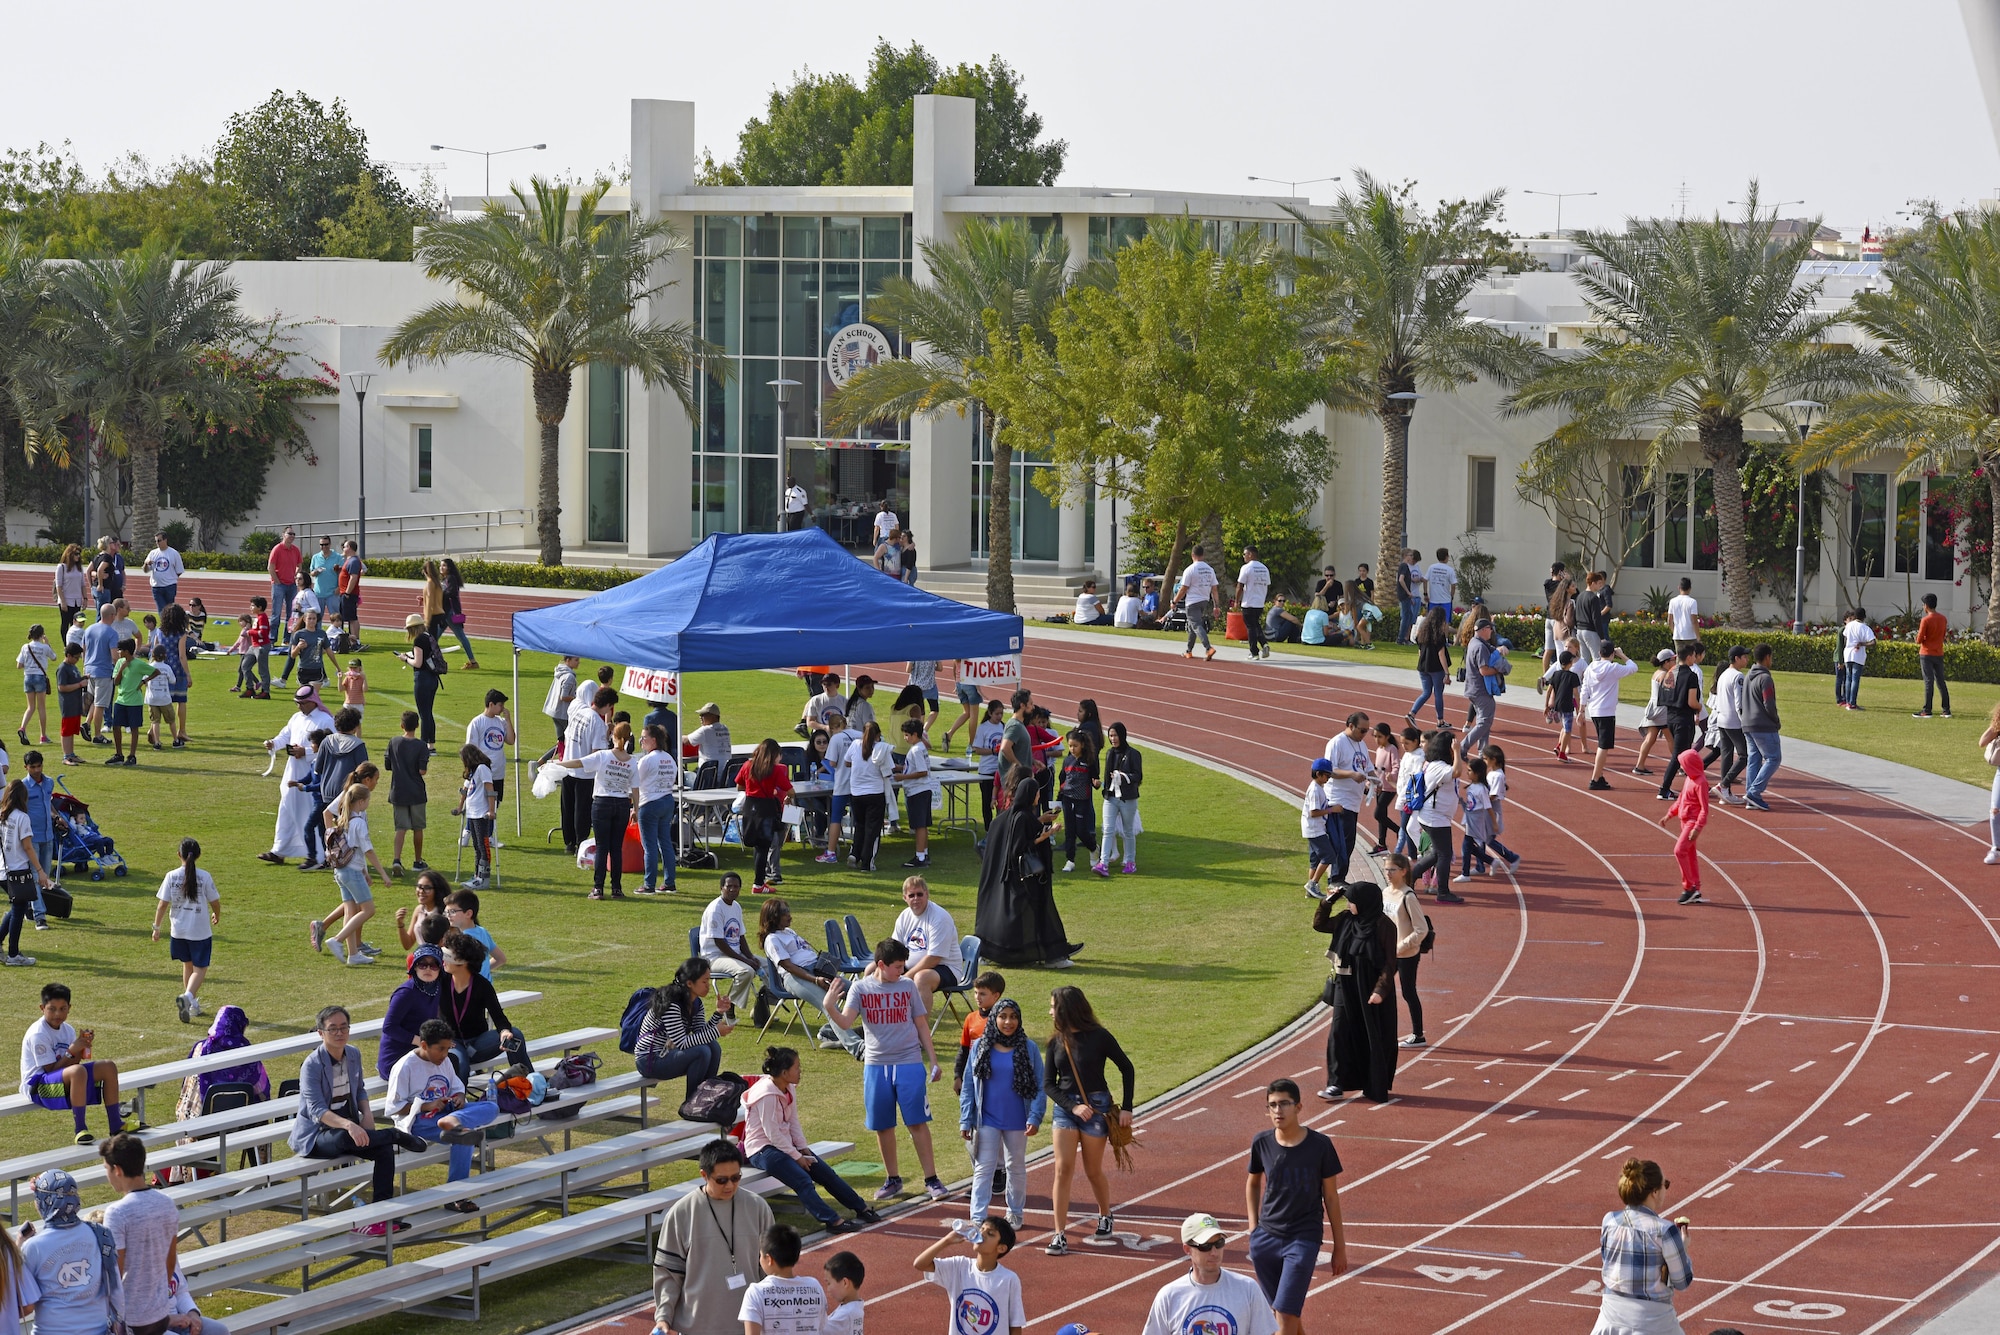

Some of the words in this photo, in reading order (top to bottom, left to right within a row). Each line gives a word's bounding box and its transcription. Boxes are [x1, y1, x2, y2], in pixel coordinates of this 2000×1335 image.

[832, 336, 845, 381] AMERICAN
[846, 329, 877, 343] SCHOOL
[877, 344, 886, 355] OF
[964, 660, 1016, 678] TICKETS
[628, 669, 677, 696] TICKETS
[610, 760, 630, 768] STAFF
[860, 993, 891, 1009] DON'T
[893, 991, 912, 1008] SAY
[866, 1007, 908, 1024] NOTHING
[1082, 1231, 1174, 1251] 2
[1413, 1254, 1504, 1283] 4
[796, 1286, 820, 1295] FESTIVAL
[764, 1297, 821, 1309] ExxonMobil
[1752, 1299, 1847, 1320] 6
